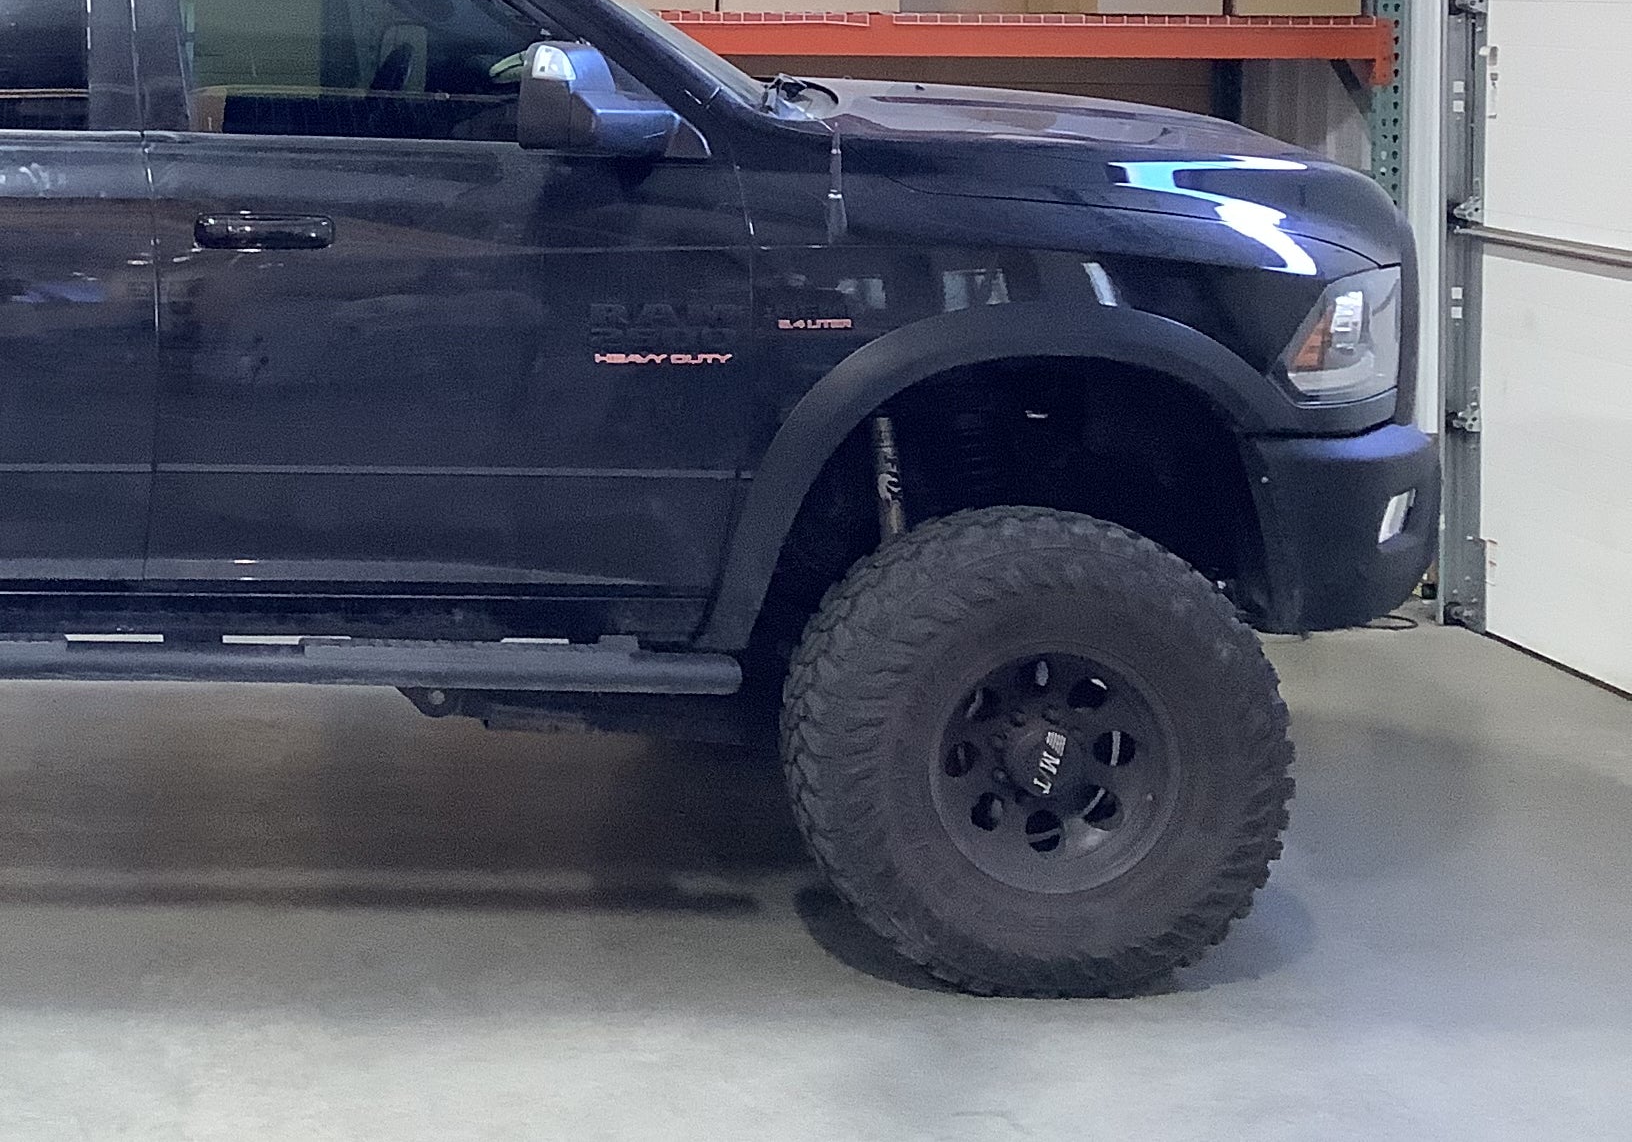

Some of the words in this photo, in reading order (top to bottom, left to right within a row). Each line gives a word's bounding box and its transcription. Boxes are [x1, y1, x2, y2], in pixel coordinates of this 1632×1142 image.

[807, 319, 852, 328] LITER
[594, 353, 667, 364] HEAVY
[670, 353, 732, 364] DUTY
[1033, 750, 1061, 795] M/T
